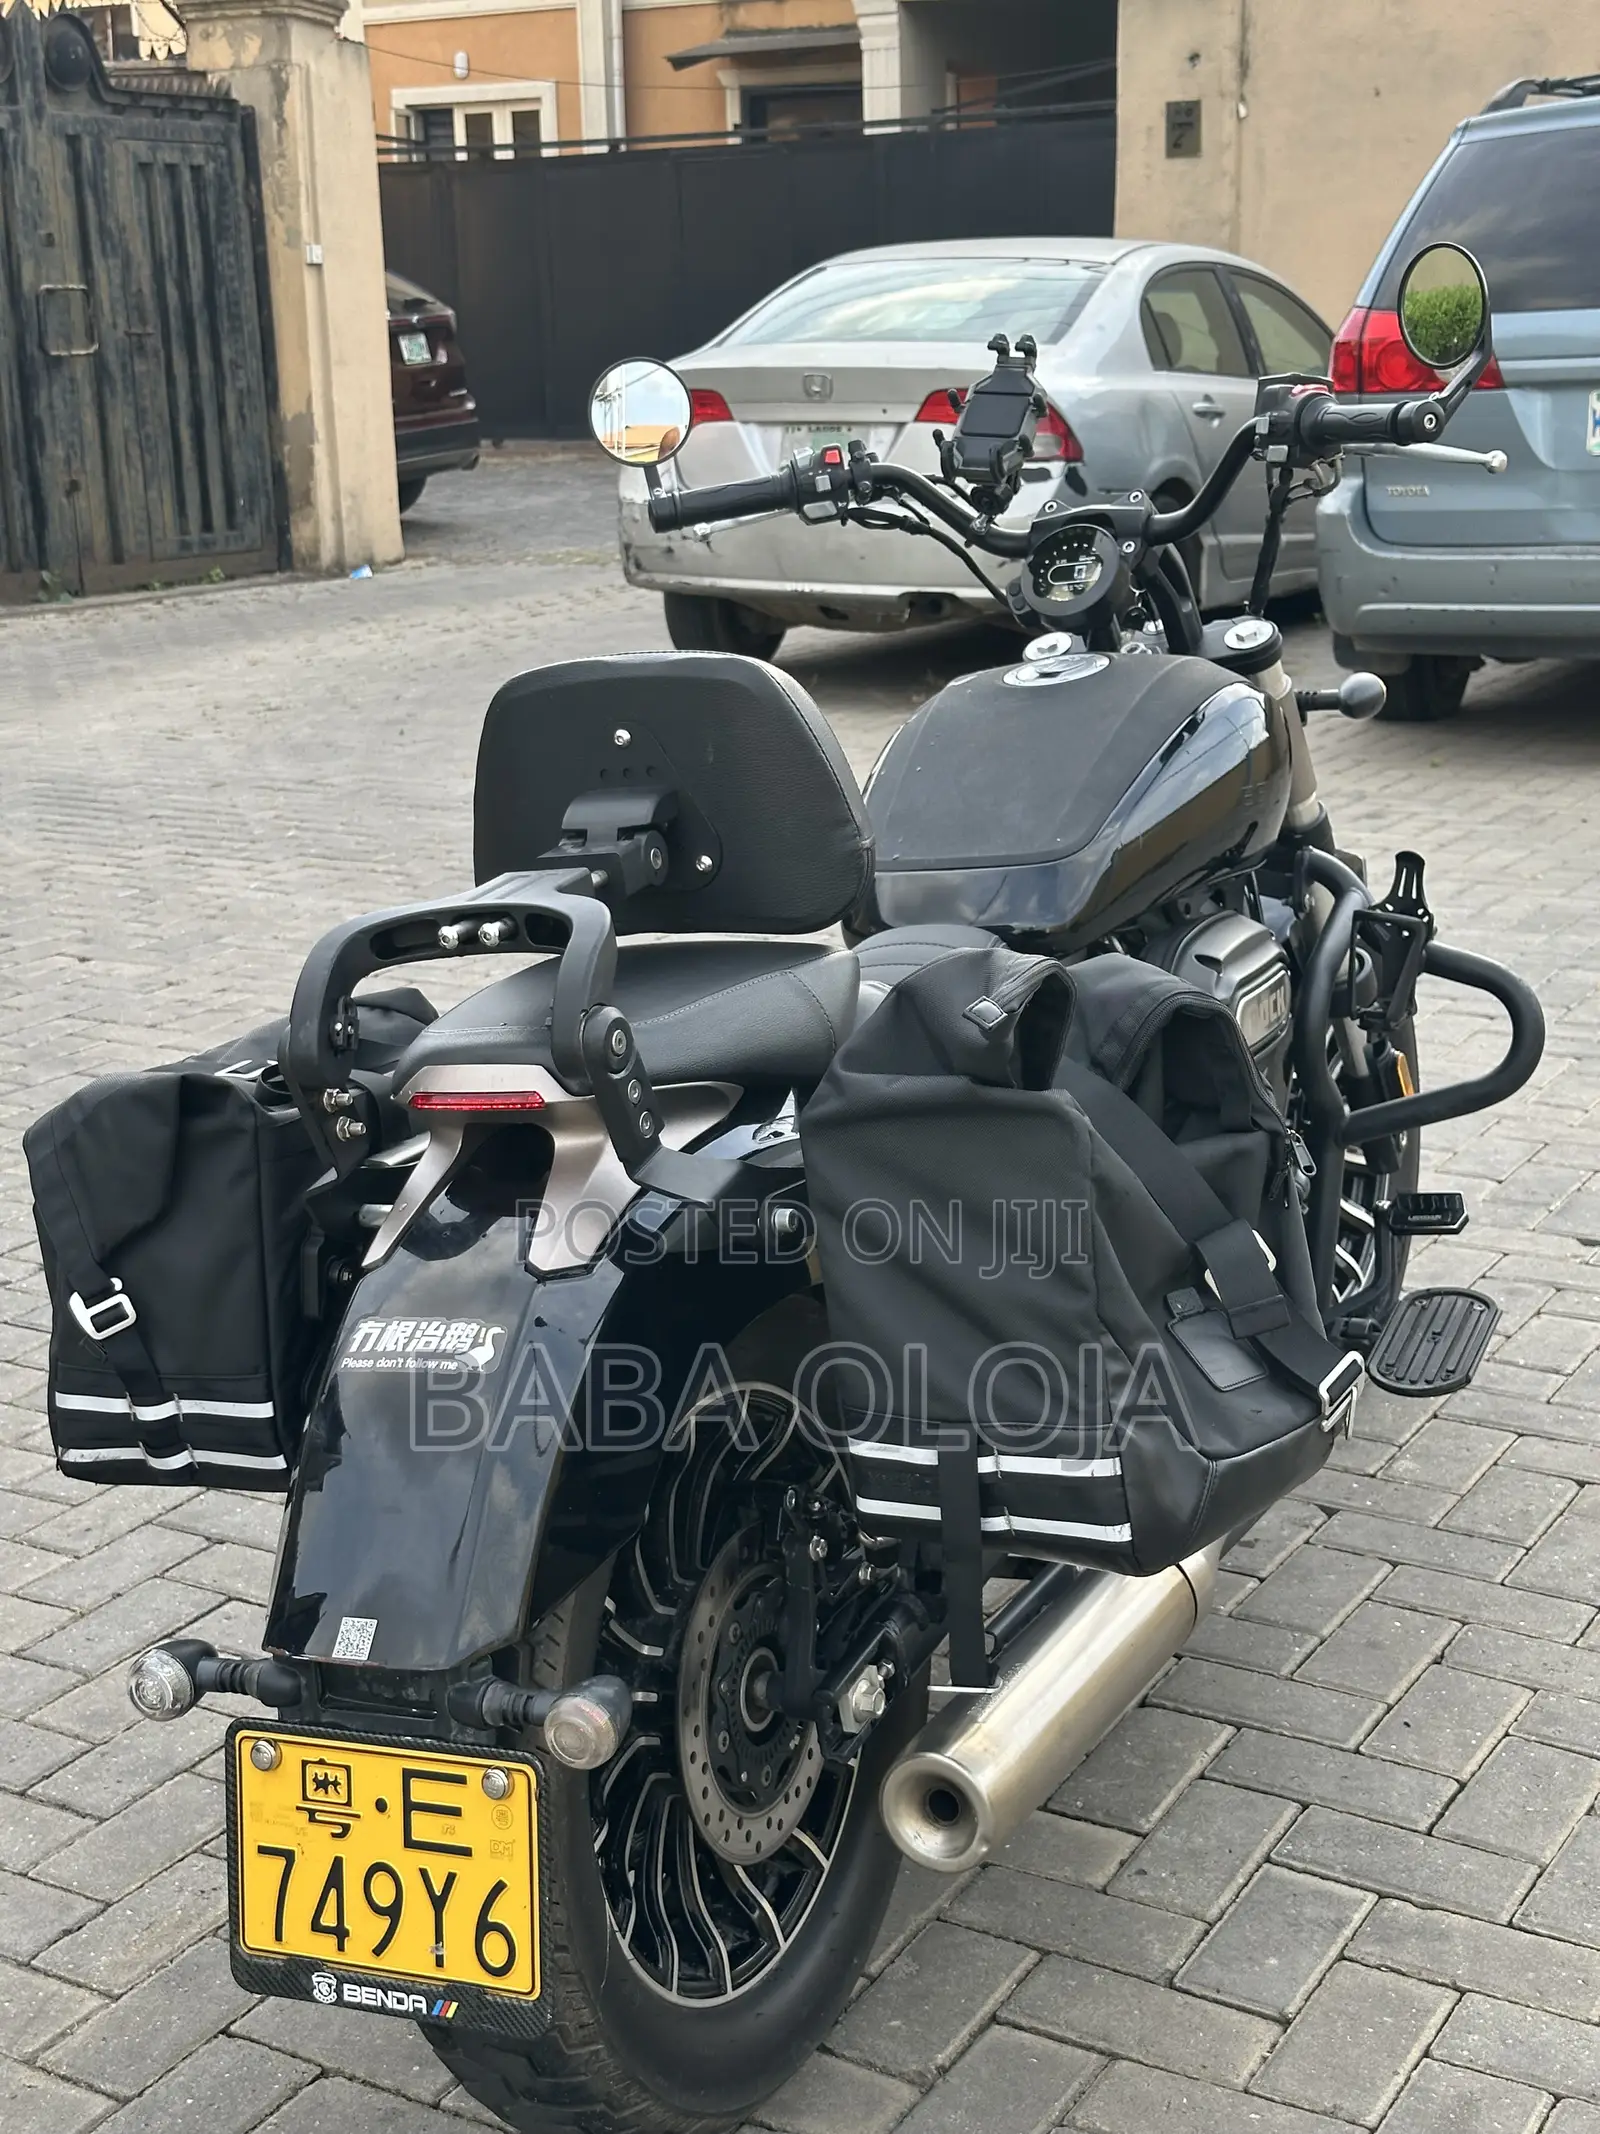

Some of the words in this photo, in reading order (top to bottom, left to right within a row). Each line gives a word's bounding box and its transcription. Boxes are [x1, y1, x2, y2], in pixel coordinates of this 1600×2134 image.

[341, 1357, 374, 1369] Please
[376, 1357, 404, 1369] don't
[405, 1357, 438, 1370] follow
[440, 1361, 459, 1371] me
[257, 1844, 516, 1978] 749Y6
[342, 1983, 428, 2015] BENDA
